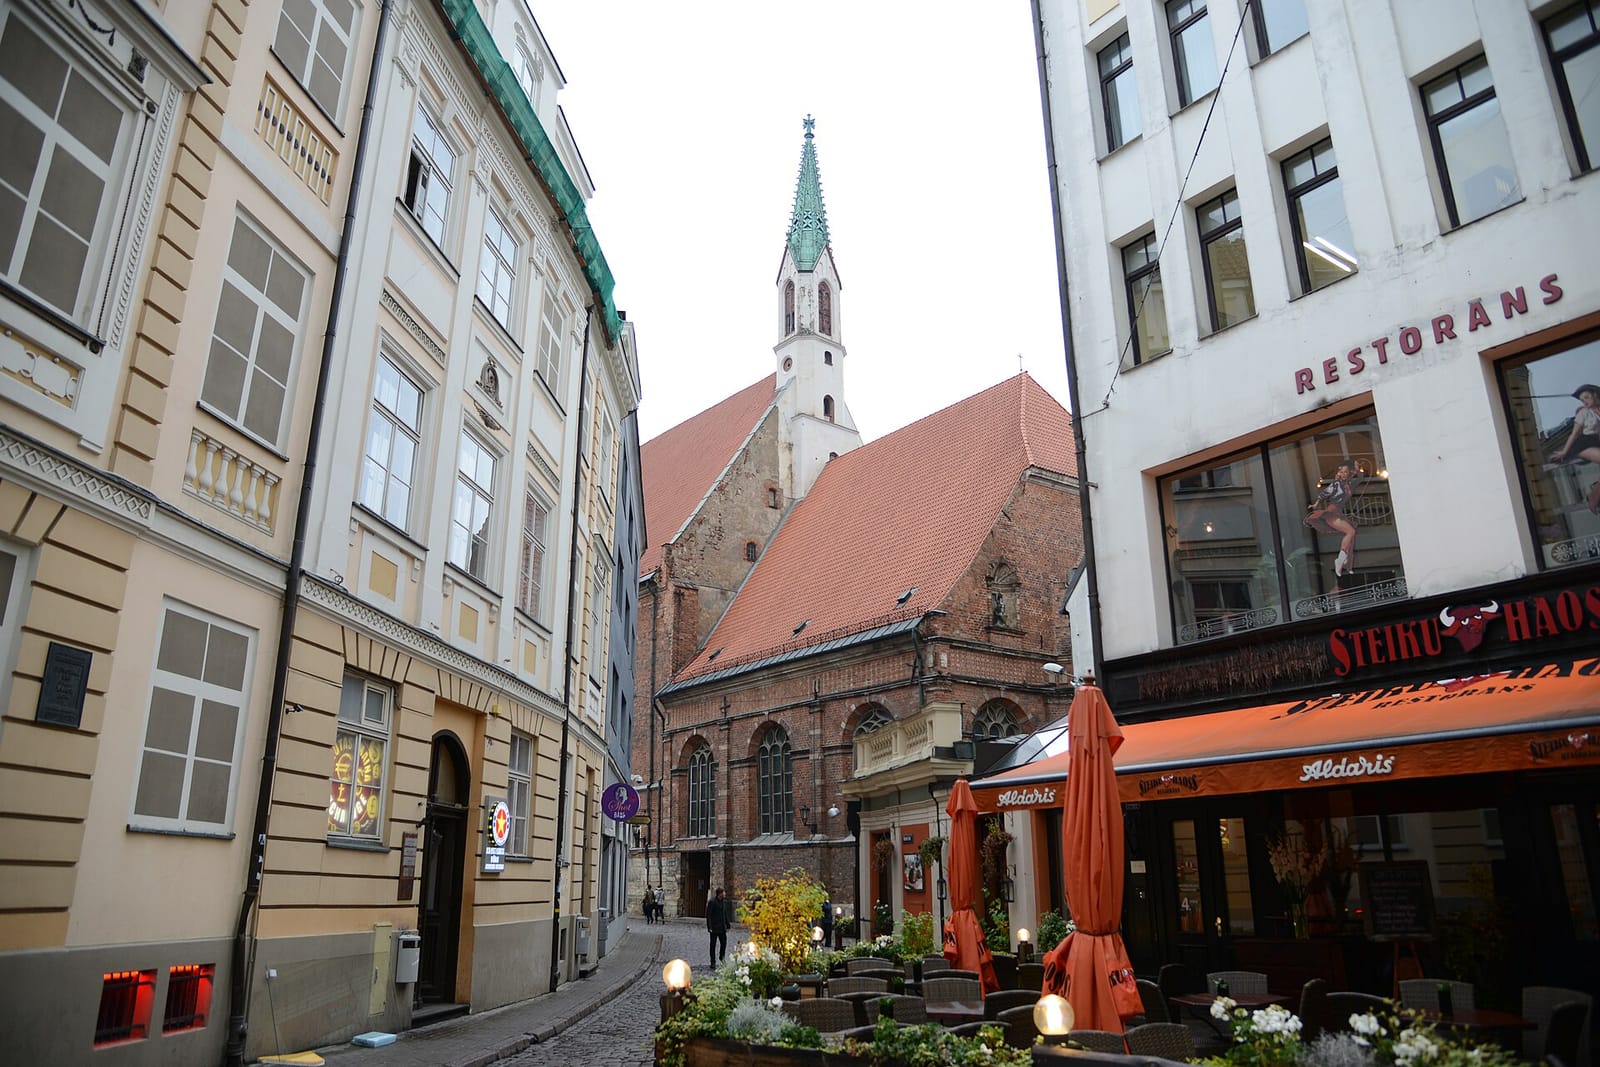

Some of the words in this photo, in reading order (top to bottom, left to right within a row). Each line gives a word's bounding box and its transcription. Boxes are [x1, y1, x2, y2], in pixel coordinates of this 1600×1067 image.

[1328, 617, 1442, 677] STEIKU
[1299, 754, 1396, 782] Aldaris
[996, 787, 1056, 807] Aldaris
